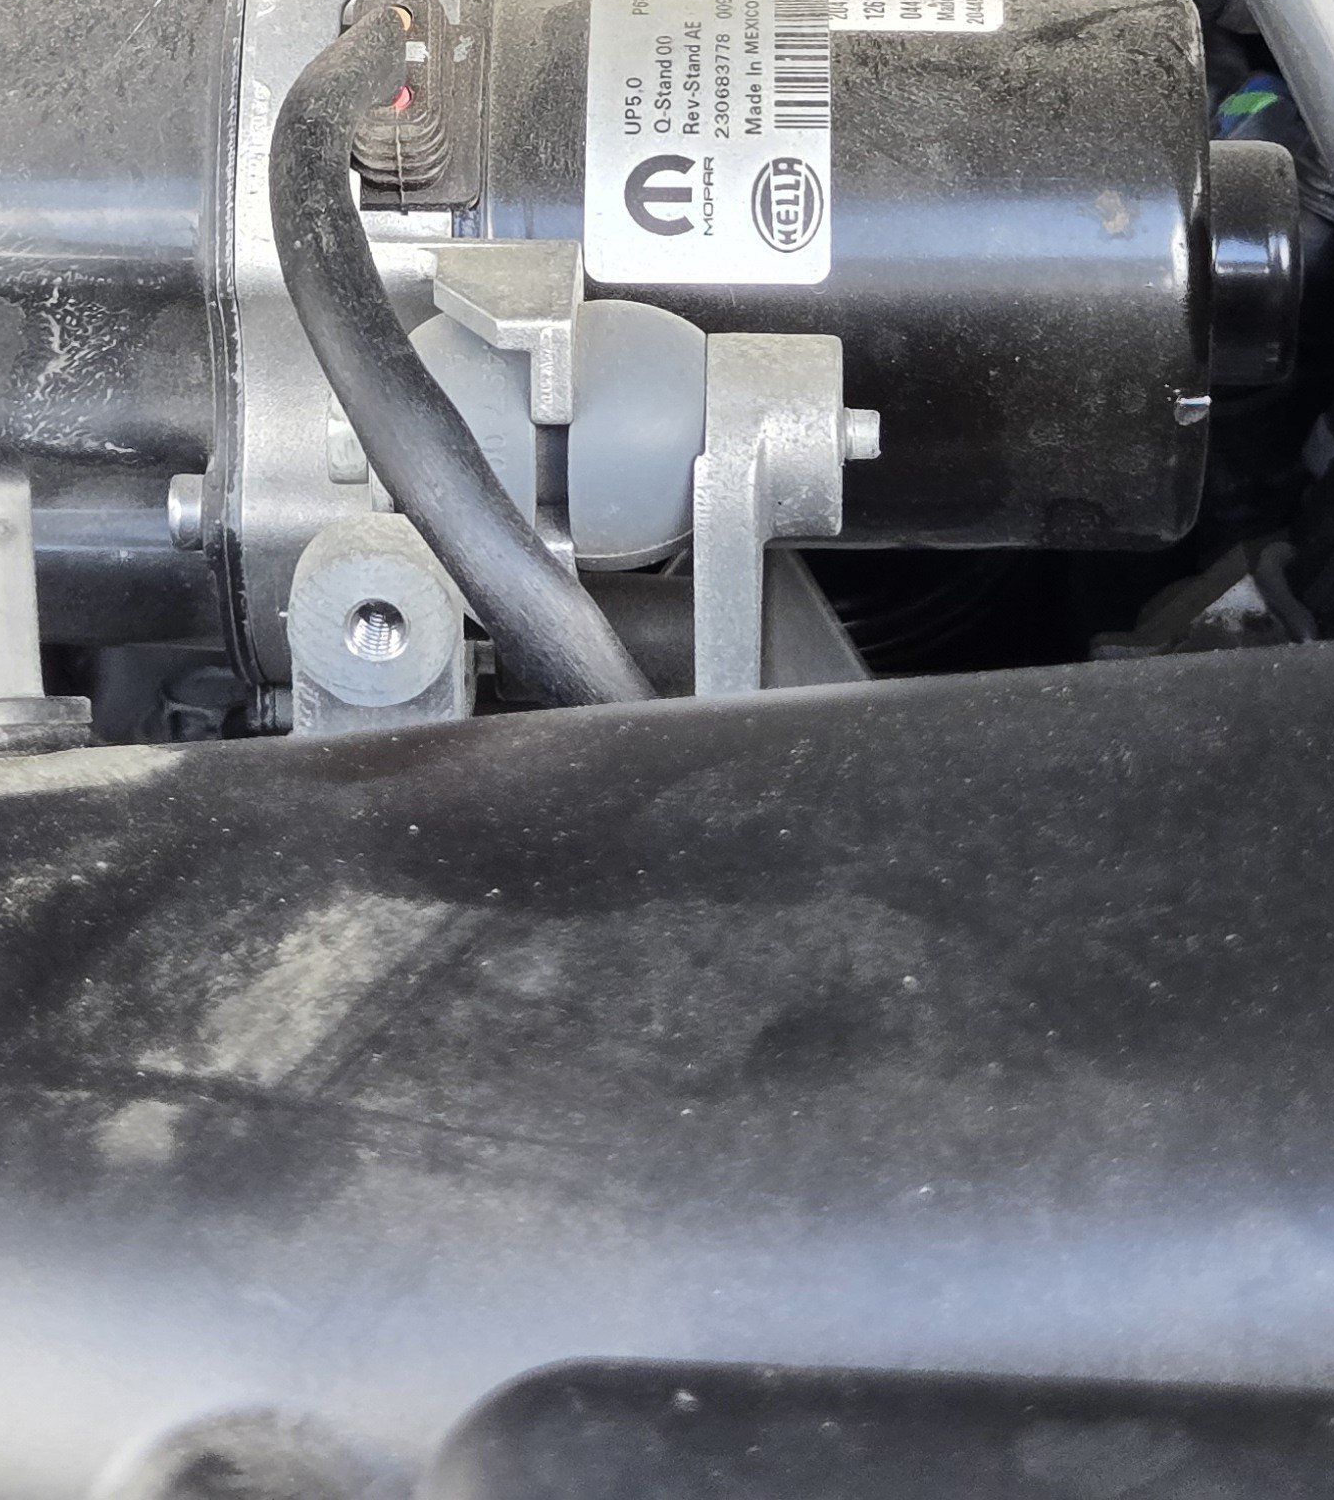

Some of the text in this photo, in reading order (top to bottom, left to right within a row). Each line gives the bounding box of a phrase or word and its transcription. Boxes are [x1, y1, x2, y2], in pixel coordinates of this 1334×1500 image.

[654, 35, 674, 134] Q-Stand 00
[682, 20, 702, 135] Rev-Stand AE
[714, 33, 731, 139] 230683778
[745, 0, 763, 135] Made In MEXICO
[703, 156, 715, 236] MOPAR
[772, 156, 804, 245] HELLA
